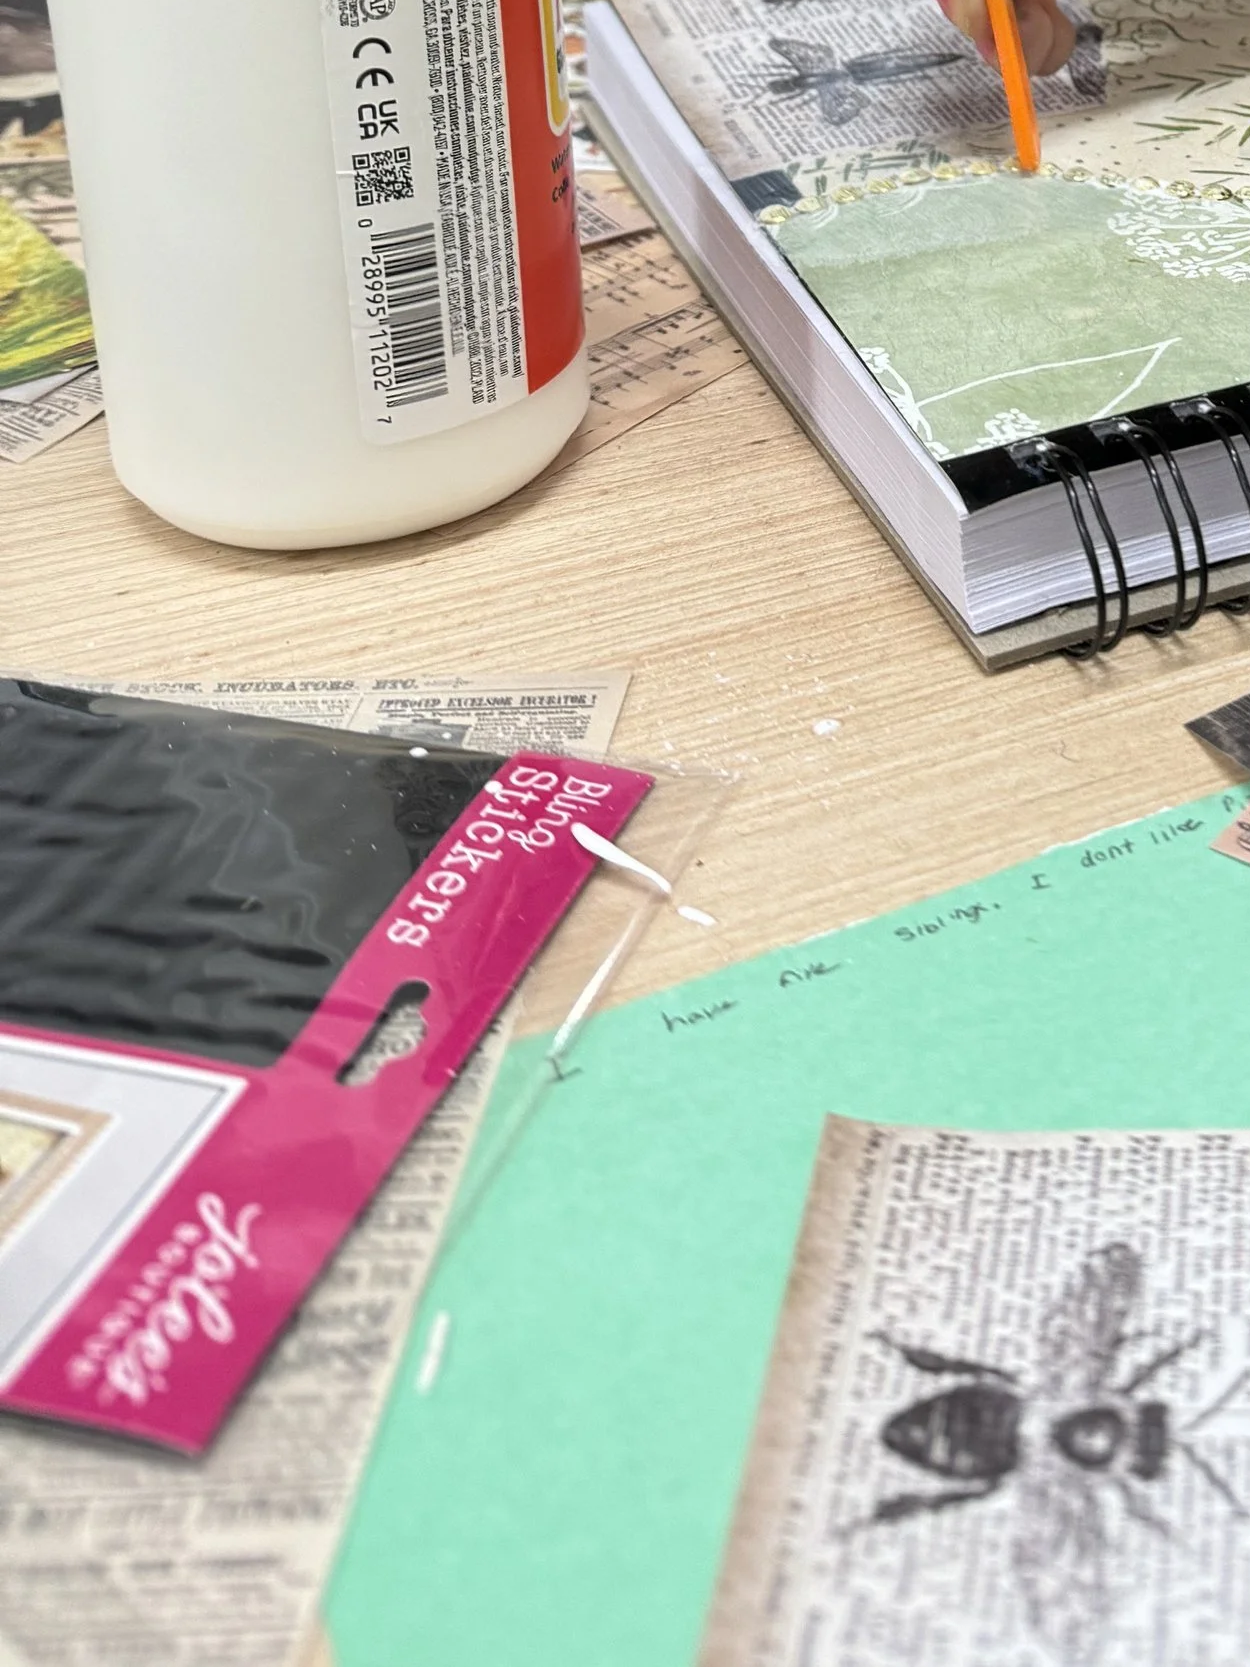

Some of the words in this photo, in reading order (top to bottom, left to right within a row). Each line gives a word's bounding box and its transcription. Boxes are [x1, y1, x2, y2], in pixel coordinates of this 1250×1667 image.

[357, 101, 378, 141] CA
[378, 98, 399, 137] UK
[512, 772, 612, 855] Bling
[386, 764, 558, 950] Stickers
[1029, 873, 1051, 891] I
[1078, 837, 1137, 870] dont
